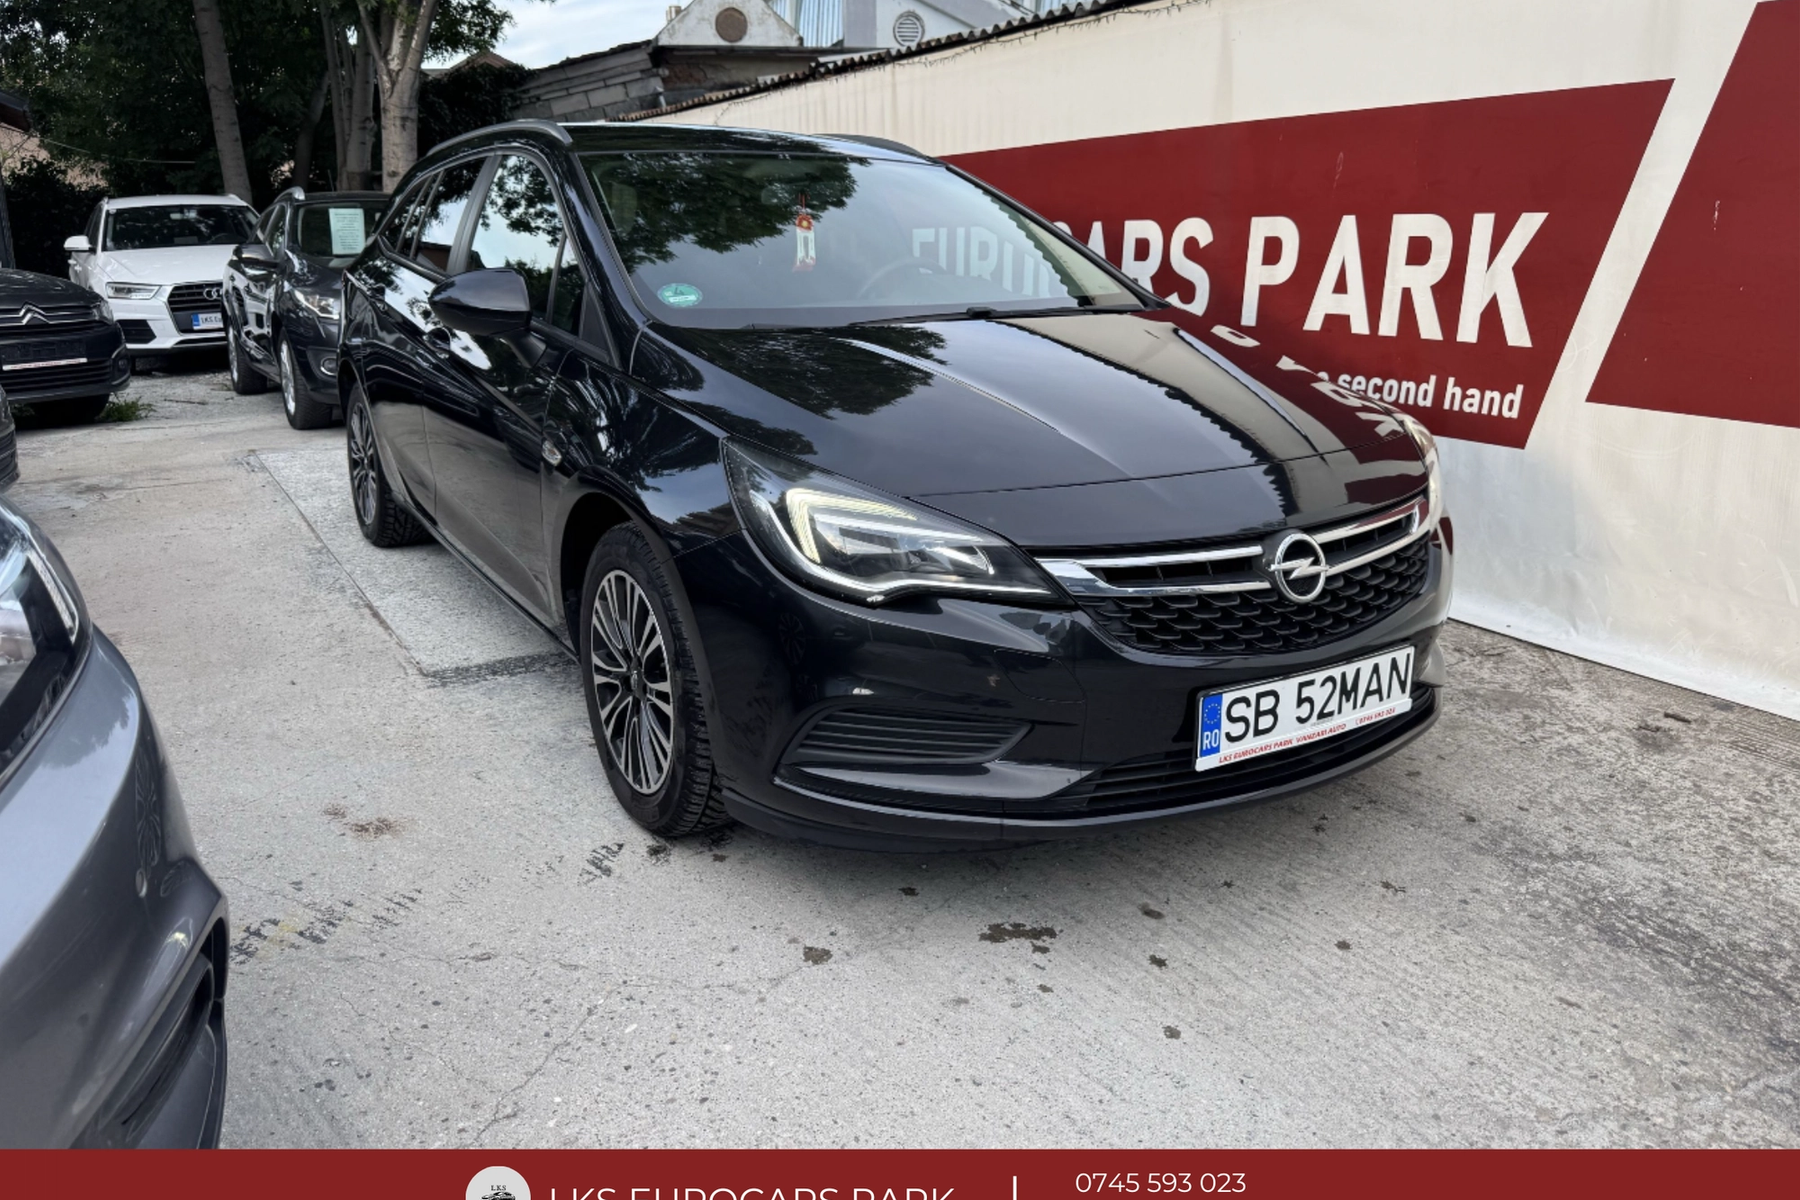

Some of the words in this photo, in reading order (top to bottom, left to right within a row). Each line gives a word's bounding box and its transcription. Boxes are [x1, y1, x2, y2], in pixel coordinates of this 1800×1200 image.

[1241, 212, 1549, 348] PARK
[1338, 374, 1437, 407] second
[1443, 376, 1524, 419] hand
[1225, 689, 1280, 743] SB
[1203, 728, 1220, 751] RO
[1273, 738, 1293, 750] PARK
